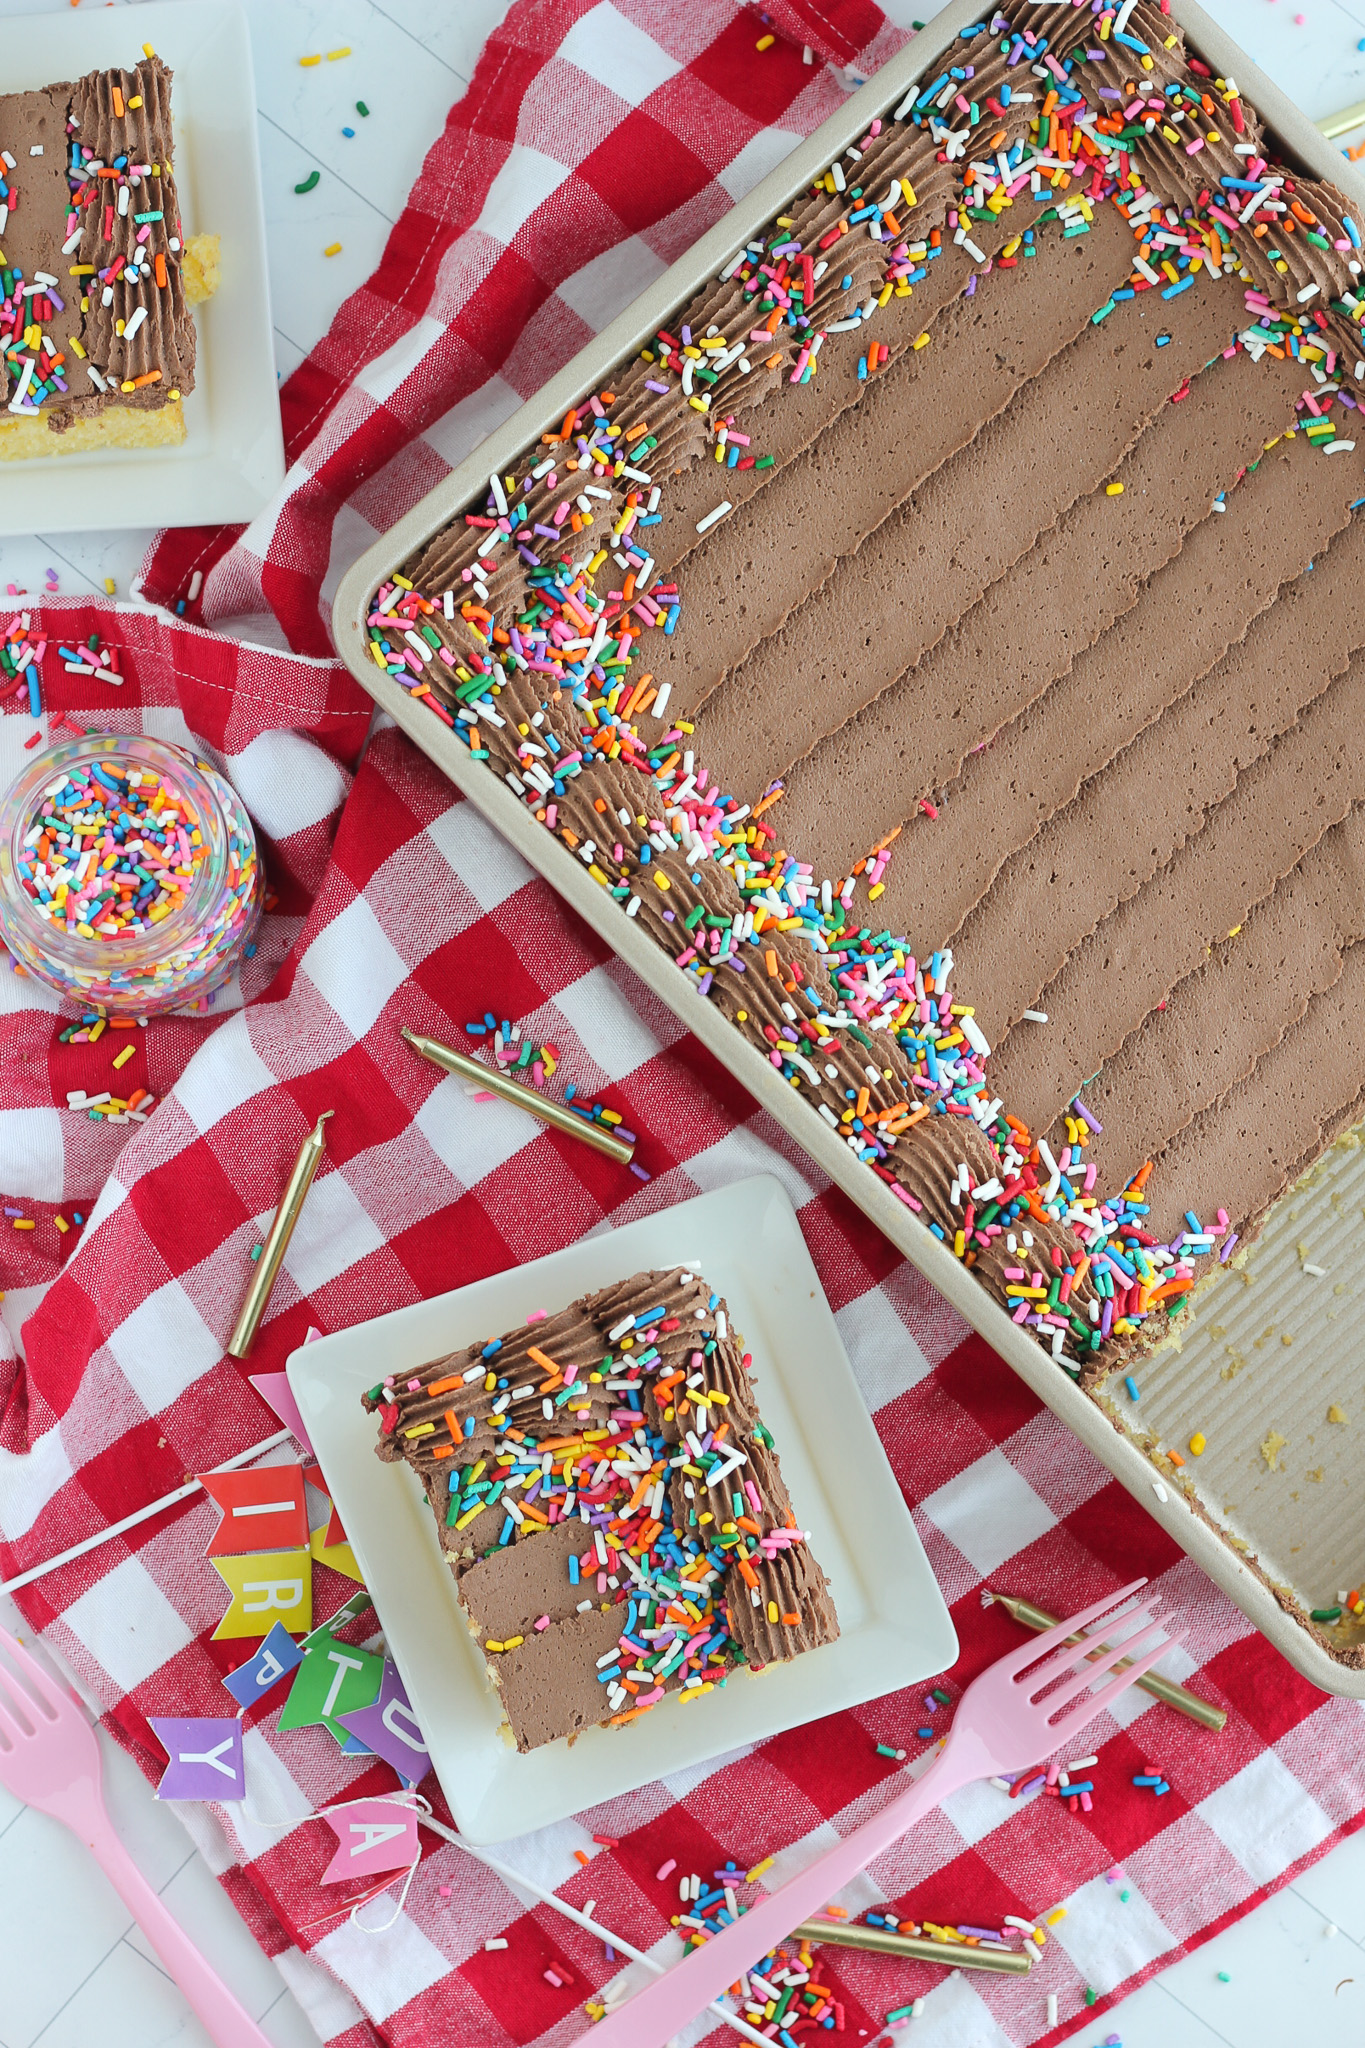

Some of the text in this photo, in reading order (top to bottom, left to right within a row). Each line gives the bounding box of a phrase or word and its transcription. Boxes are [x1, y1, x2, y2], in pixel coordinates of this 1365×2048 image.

[243, 1578, 303, 1613] R
[255, 1649, 285, 1686] P
[321, 1650, 363, 1717] T
[178, 1736, 237, 1780] Y
[349, 1823, 407, 1858] A
